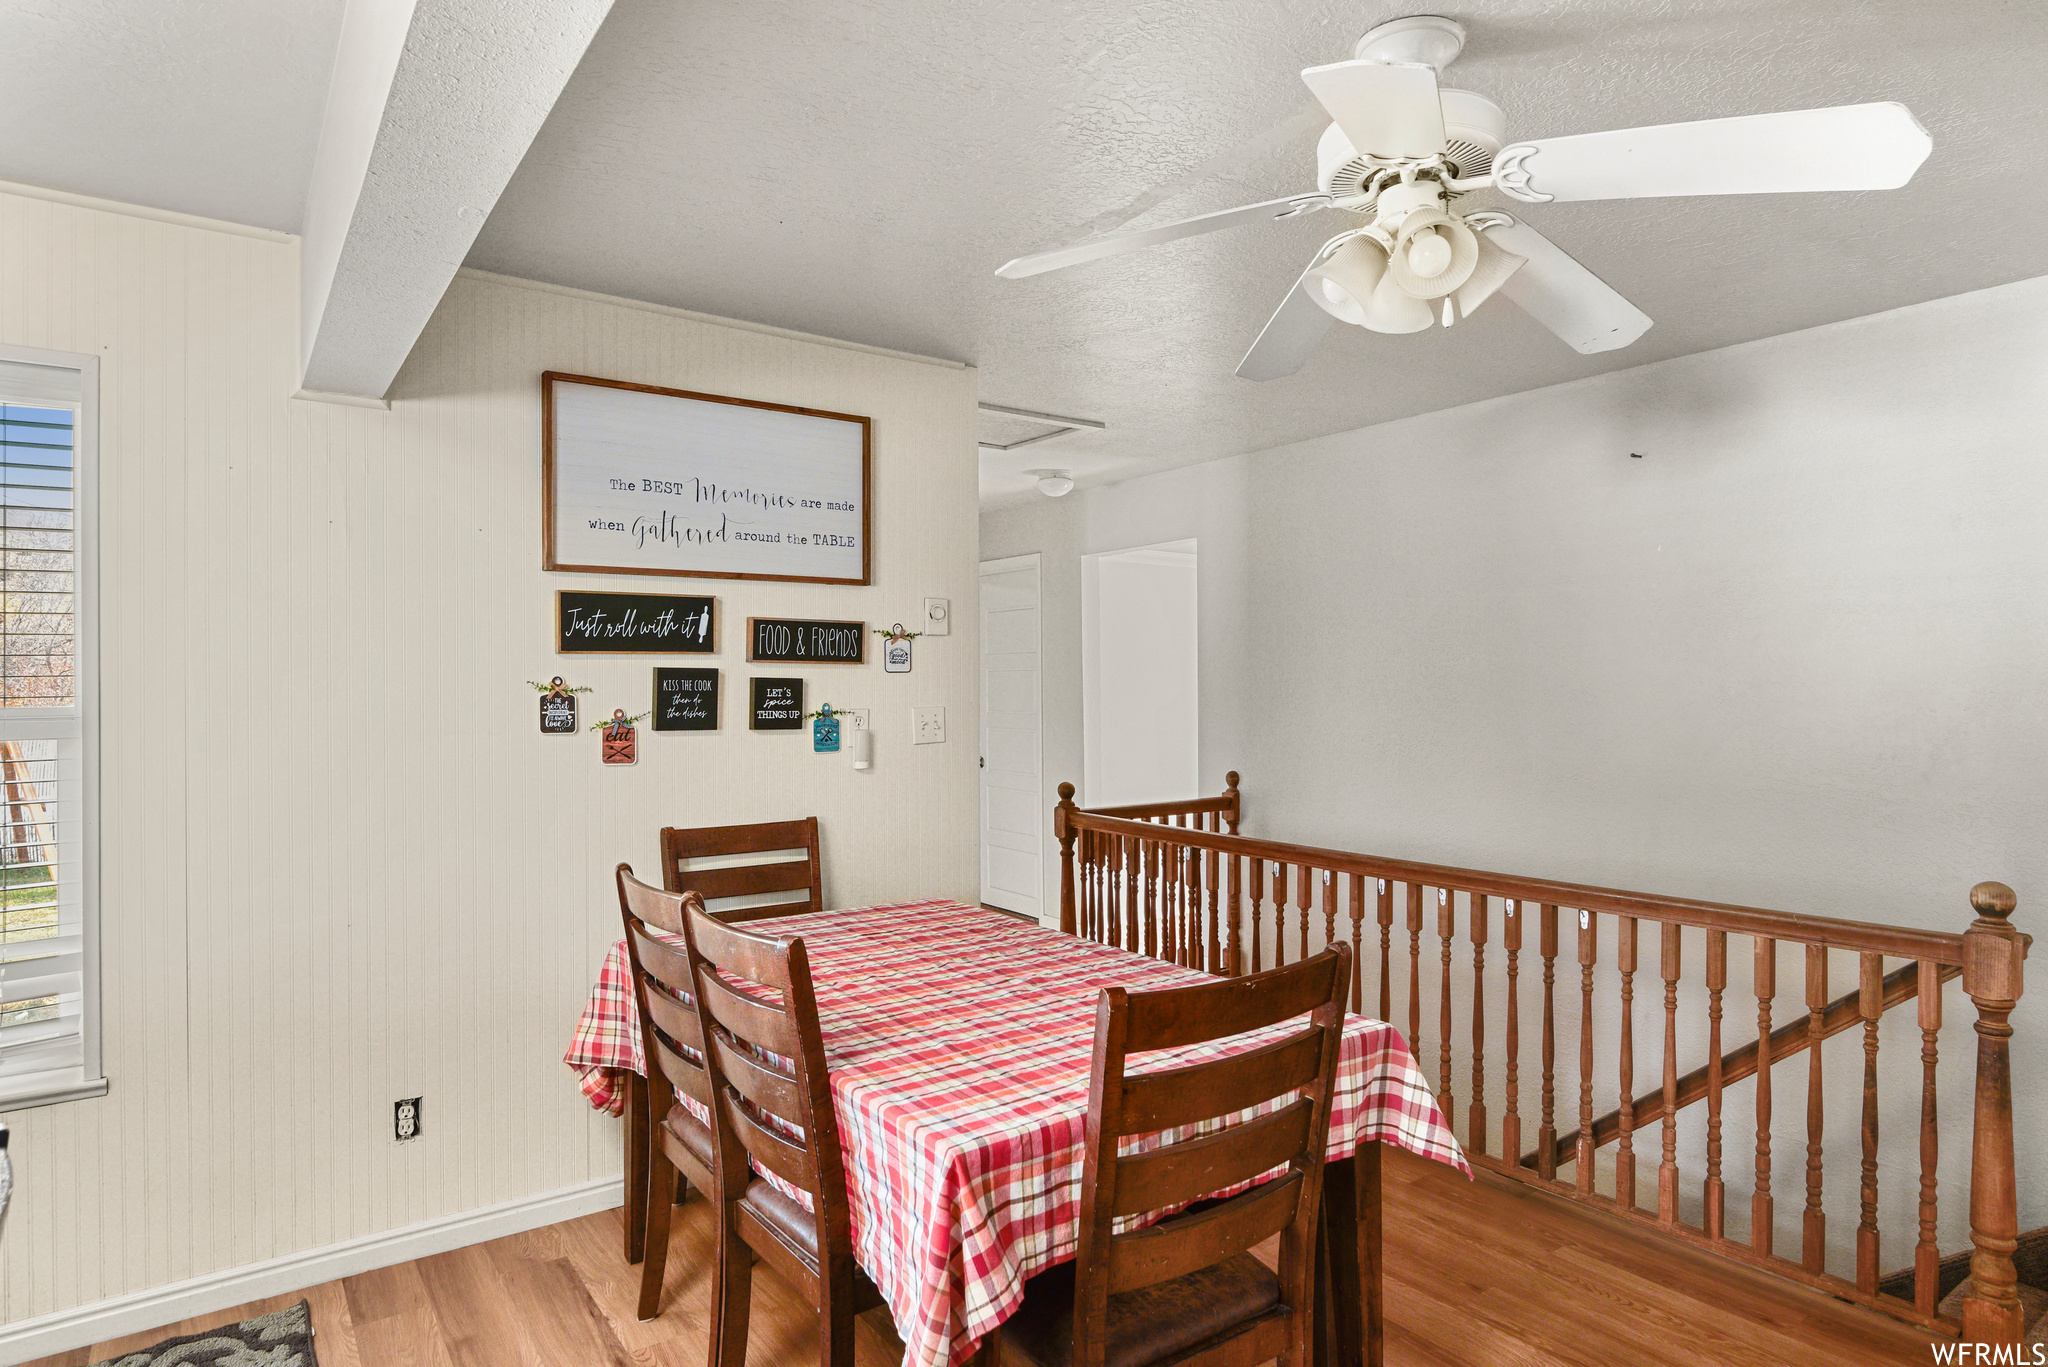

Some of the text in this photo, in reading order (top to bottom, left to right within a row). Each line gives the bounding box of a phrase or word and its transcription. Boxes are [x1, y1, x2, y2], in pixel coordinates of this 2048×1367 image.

[609, 477, 855, 512] The BEST Memories are made
[588, 519, 625, 532] when
[734, 531, 781, 544] around
[787, 534, 808, 545] the
[812, 534, 855, 548] TABLE
[565, 608, 699, 638] Just roll with it
[759, 624, 791, 655] FOOD
[796, 627, 805, 656] &
[663, 679, 712, 691] KISS THE COOK
[767, 687, 791, 697] LET'S
[547, 701, 570, 709] secret
[672, 693, 703, 706] then do
[763, 698, 794, 709] spice
[666, 706, 707, 719] the dishes
[757, 710, 800, 719] THINGS UP
[606, 728, 631, 742] eat
